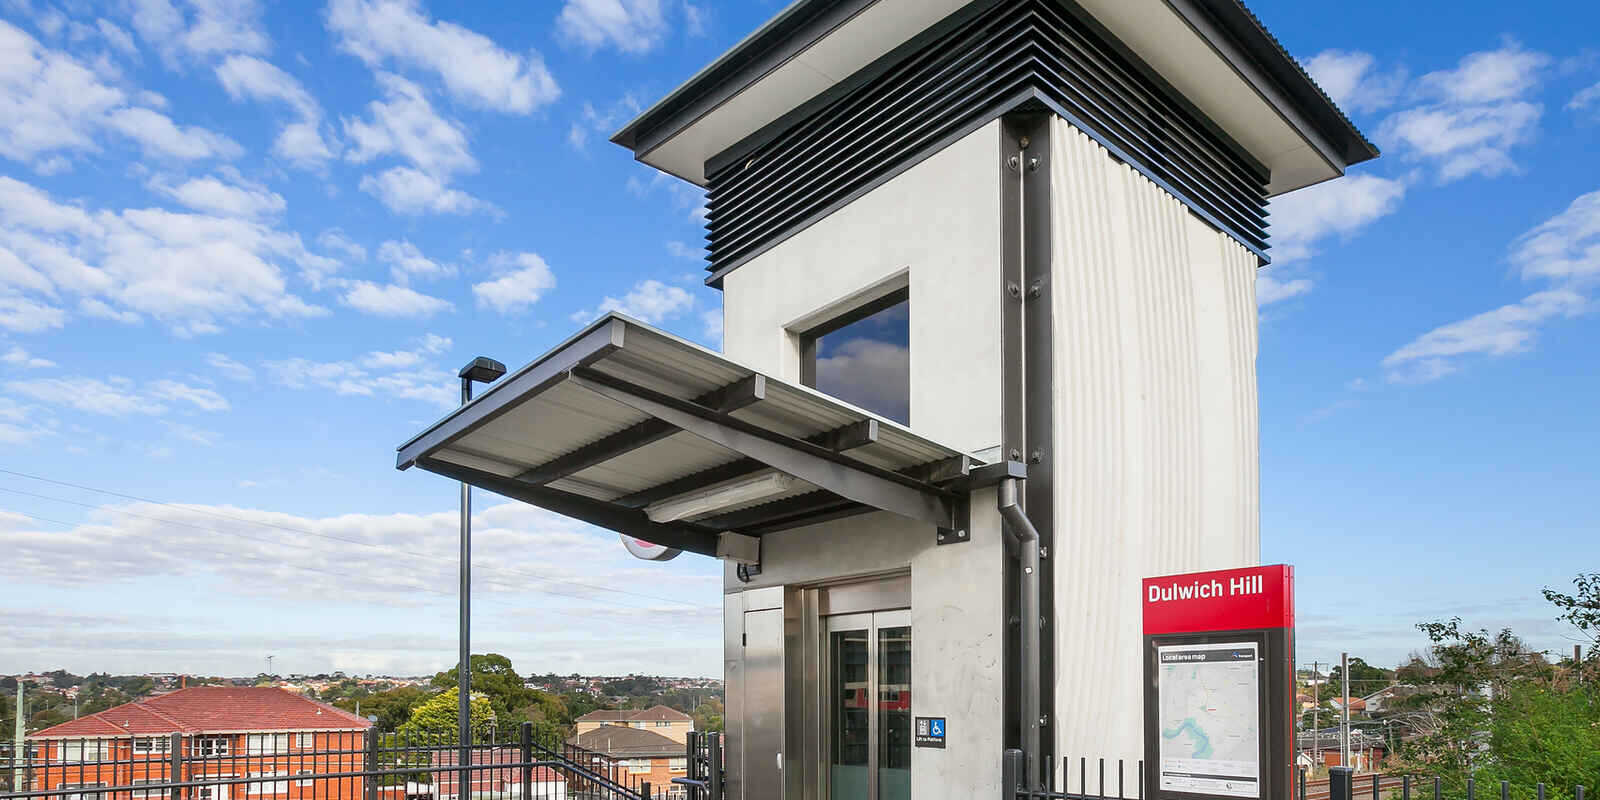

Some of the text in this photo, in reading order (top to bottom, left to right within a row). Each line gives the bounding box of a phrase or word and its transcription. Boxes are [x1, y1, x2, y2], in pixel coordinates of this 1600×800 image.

[1148, 575, 1263, 602] Dulwich Hill
[1191, 654, 1206, 662] map
